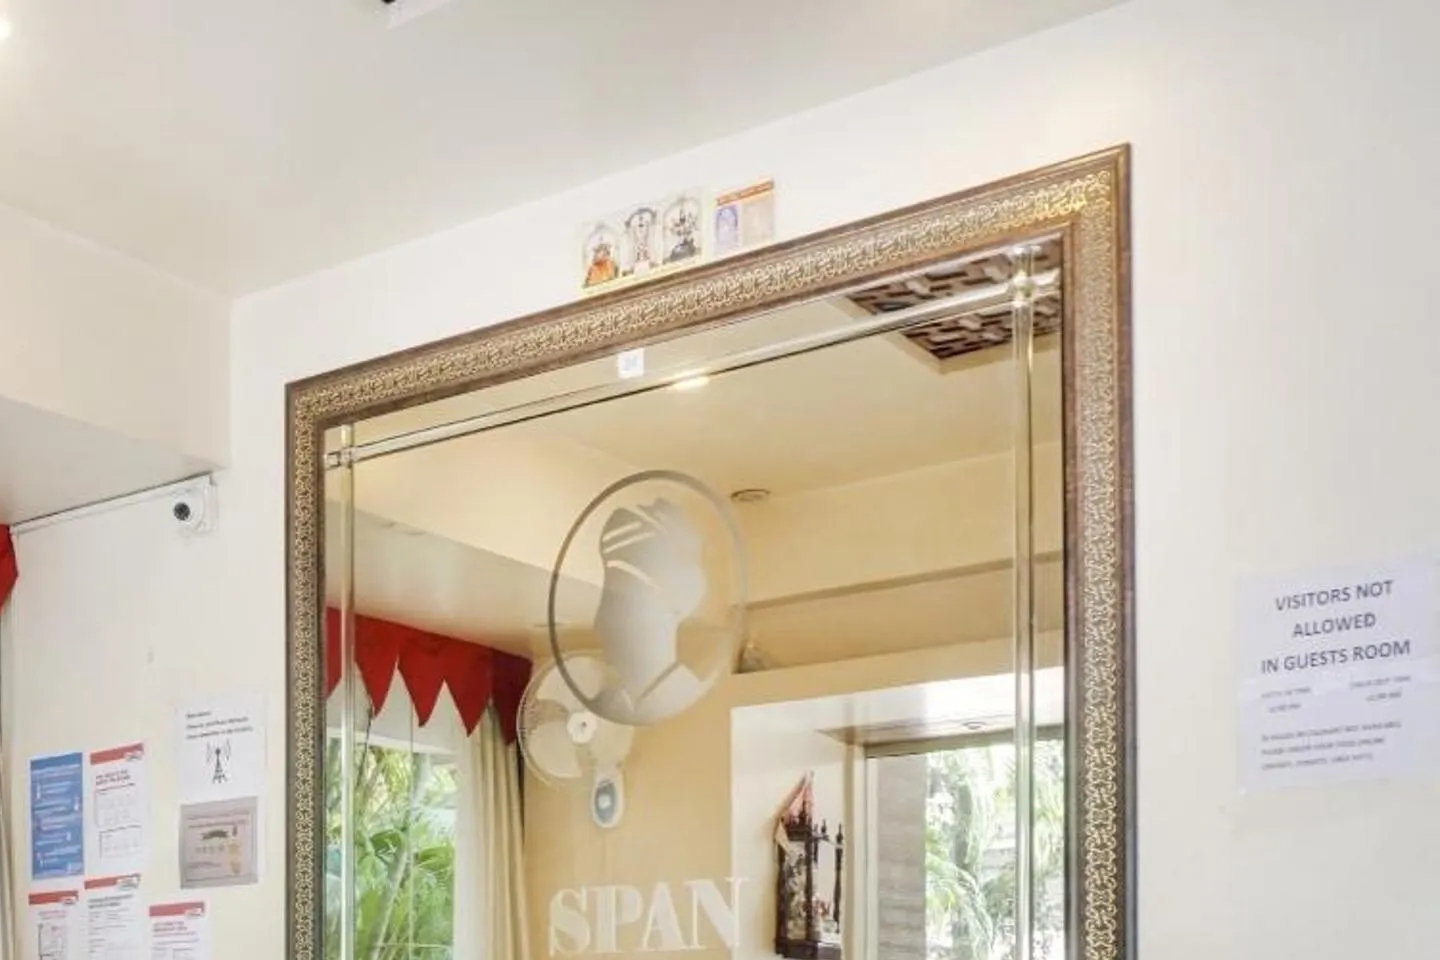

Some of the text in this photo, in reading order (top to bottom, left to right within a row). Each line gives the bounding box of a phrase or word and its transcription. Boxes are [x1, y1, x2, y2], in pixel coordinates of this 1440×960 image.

[1275, 579, 1394, 612] VISITORS NOT
[1292, 612, 1376, 638] ALLOWED
[1261, 639, 1411, 675] IN GUESTS ROOM
[548, 877, 750, 957] SPAN
